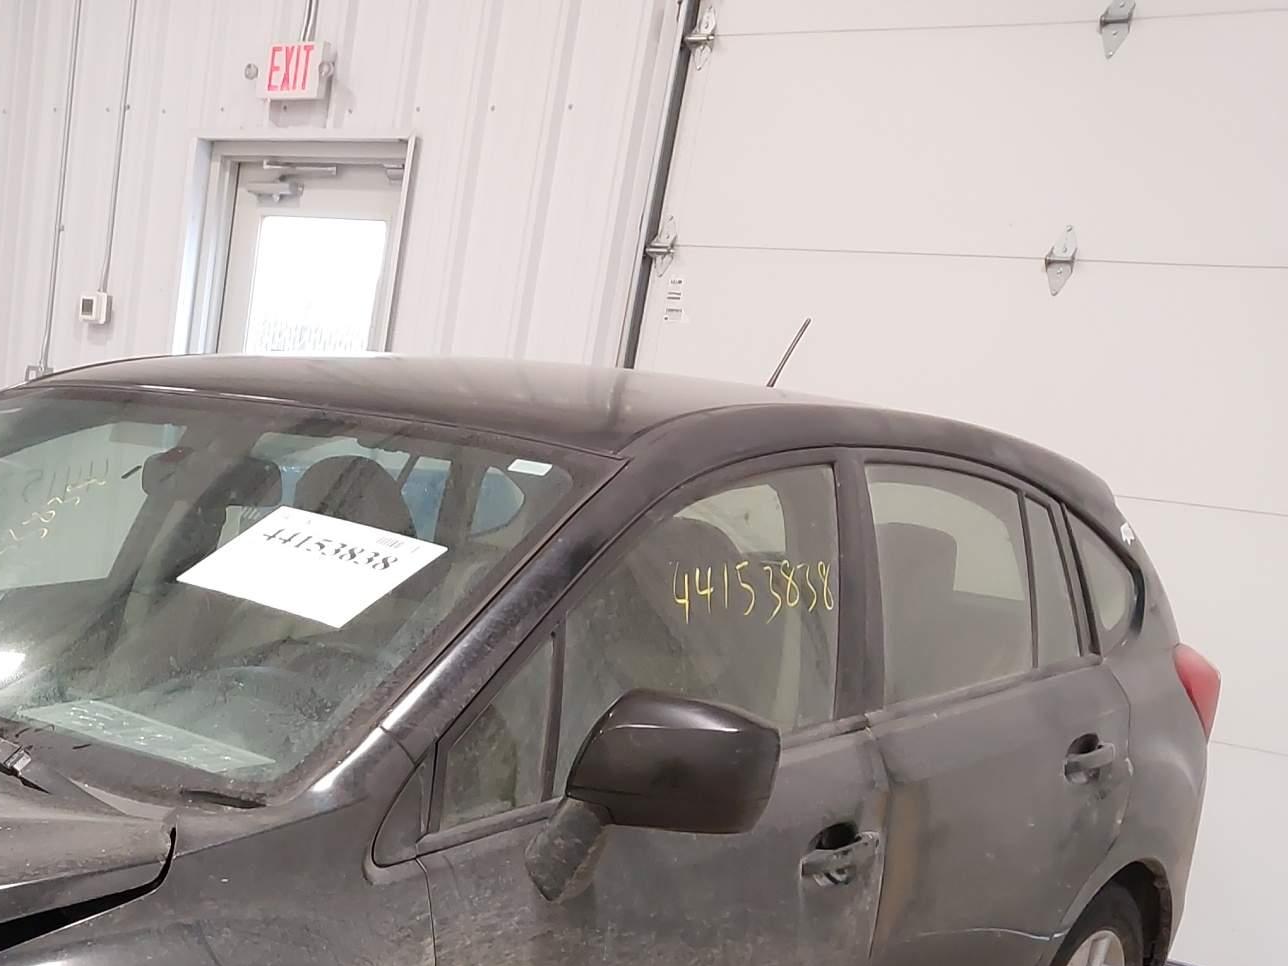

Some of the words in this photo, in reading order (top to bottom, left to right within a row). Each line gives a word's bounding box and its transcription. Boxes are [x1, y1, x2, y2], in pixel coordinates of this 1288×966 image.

[267, 44, 314, 91] EXIT
[262, 528, 399, 571] 44153838
[673, 559, 834, 625] 44153838
